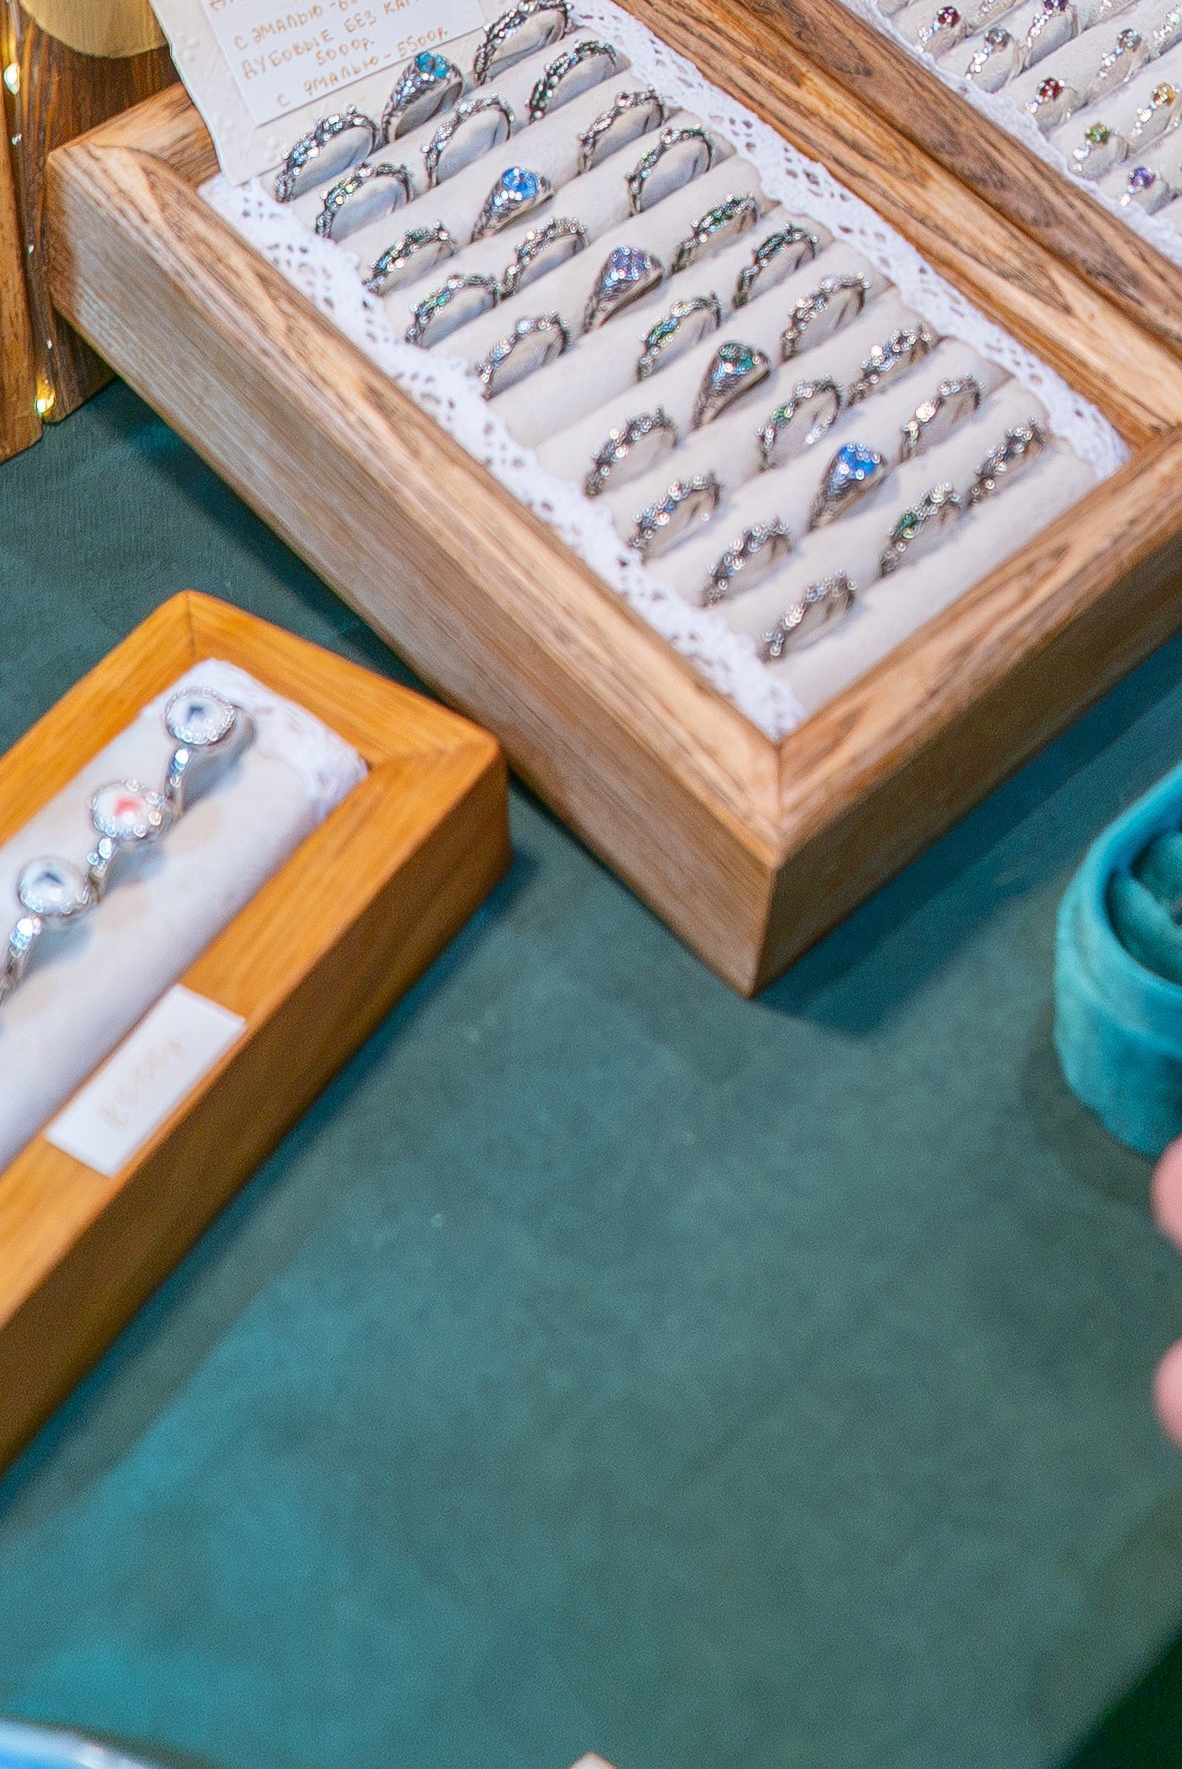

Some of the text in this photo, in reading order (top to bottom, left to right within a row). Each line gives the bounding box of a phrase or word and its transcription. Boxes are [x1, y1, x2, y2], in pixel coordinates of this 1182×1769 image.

[242, 29, 335, 79] ДУБОВЫЕ
[344, 10, 377, 33] БЕЗ
[252, 5, 323, 44] ЭМАЛЬЮ
